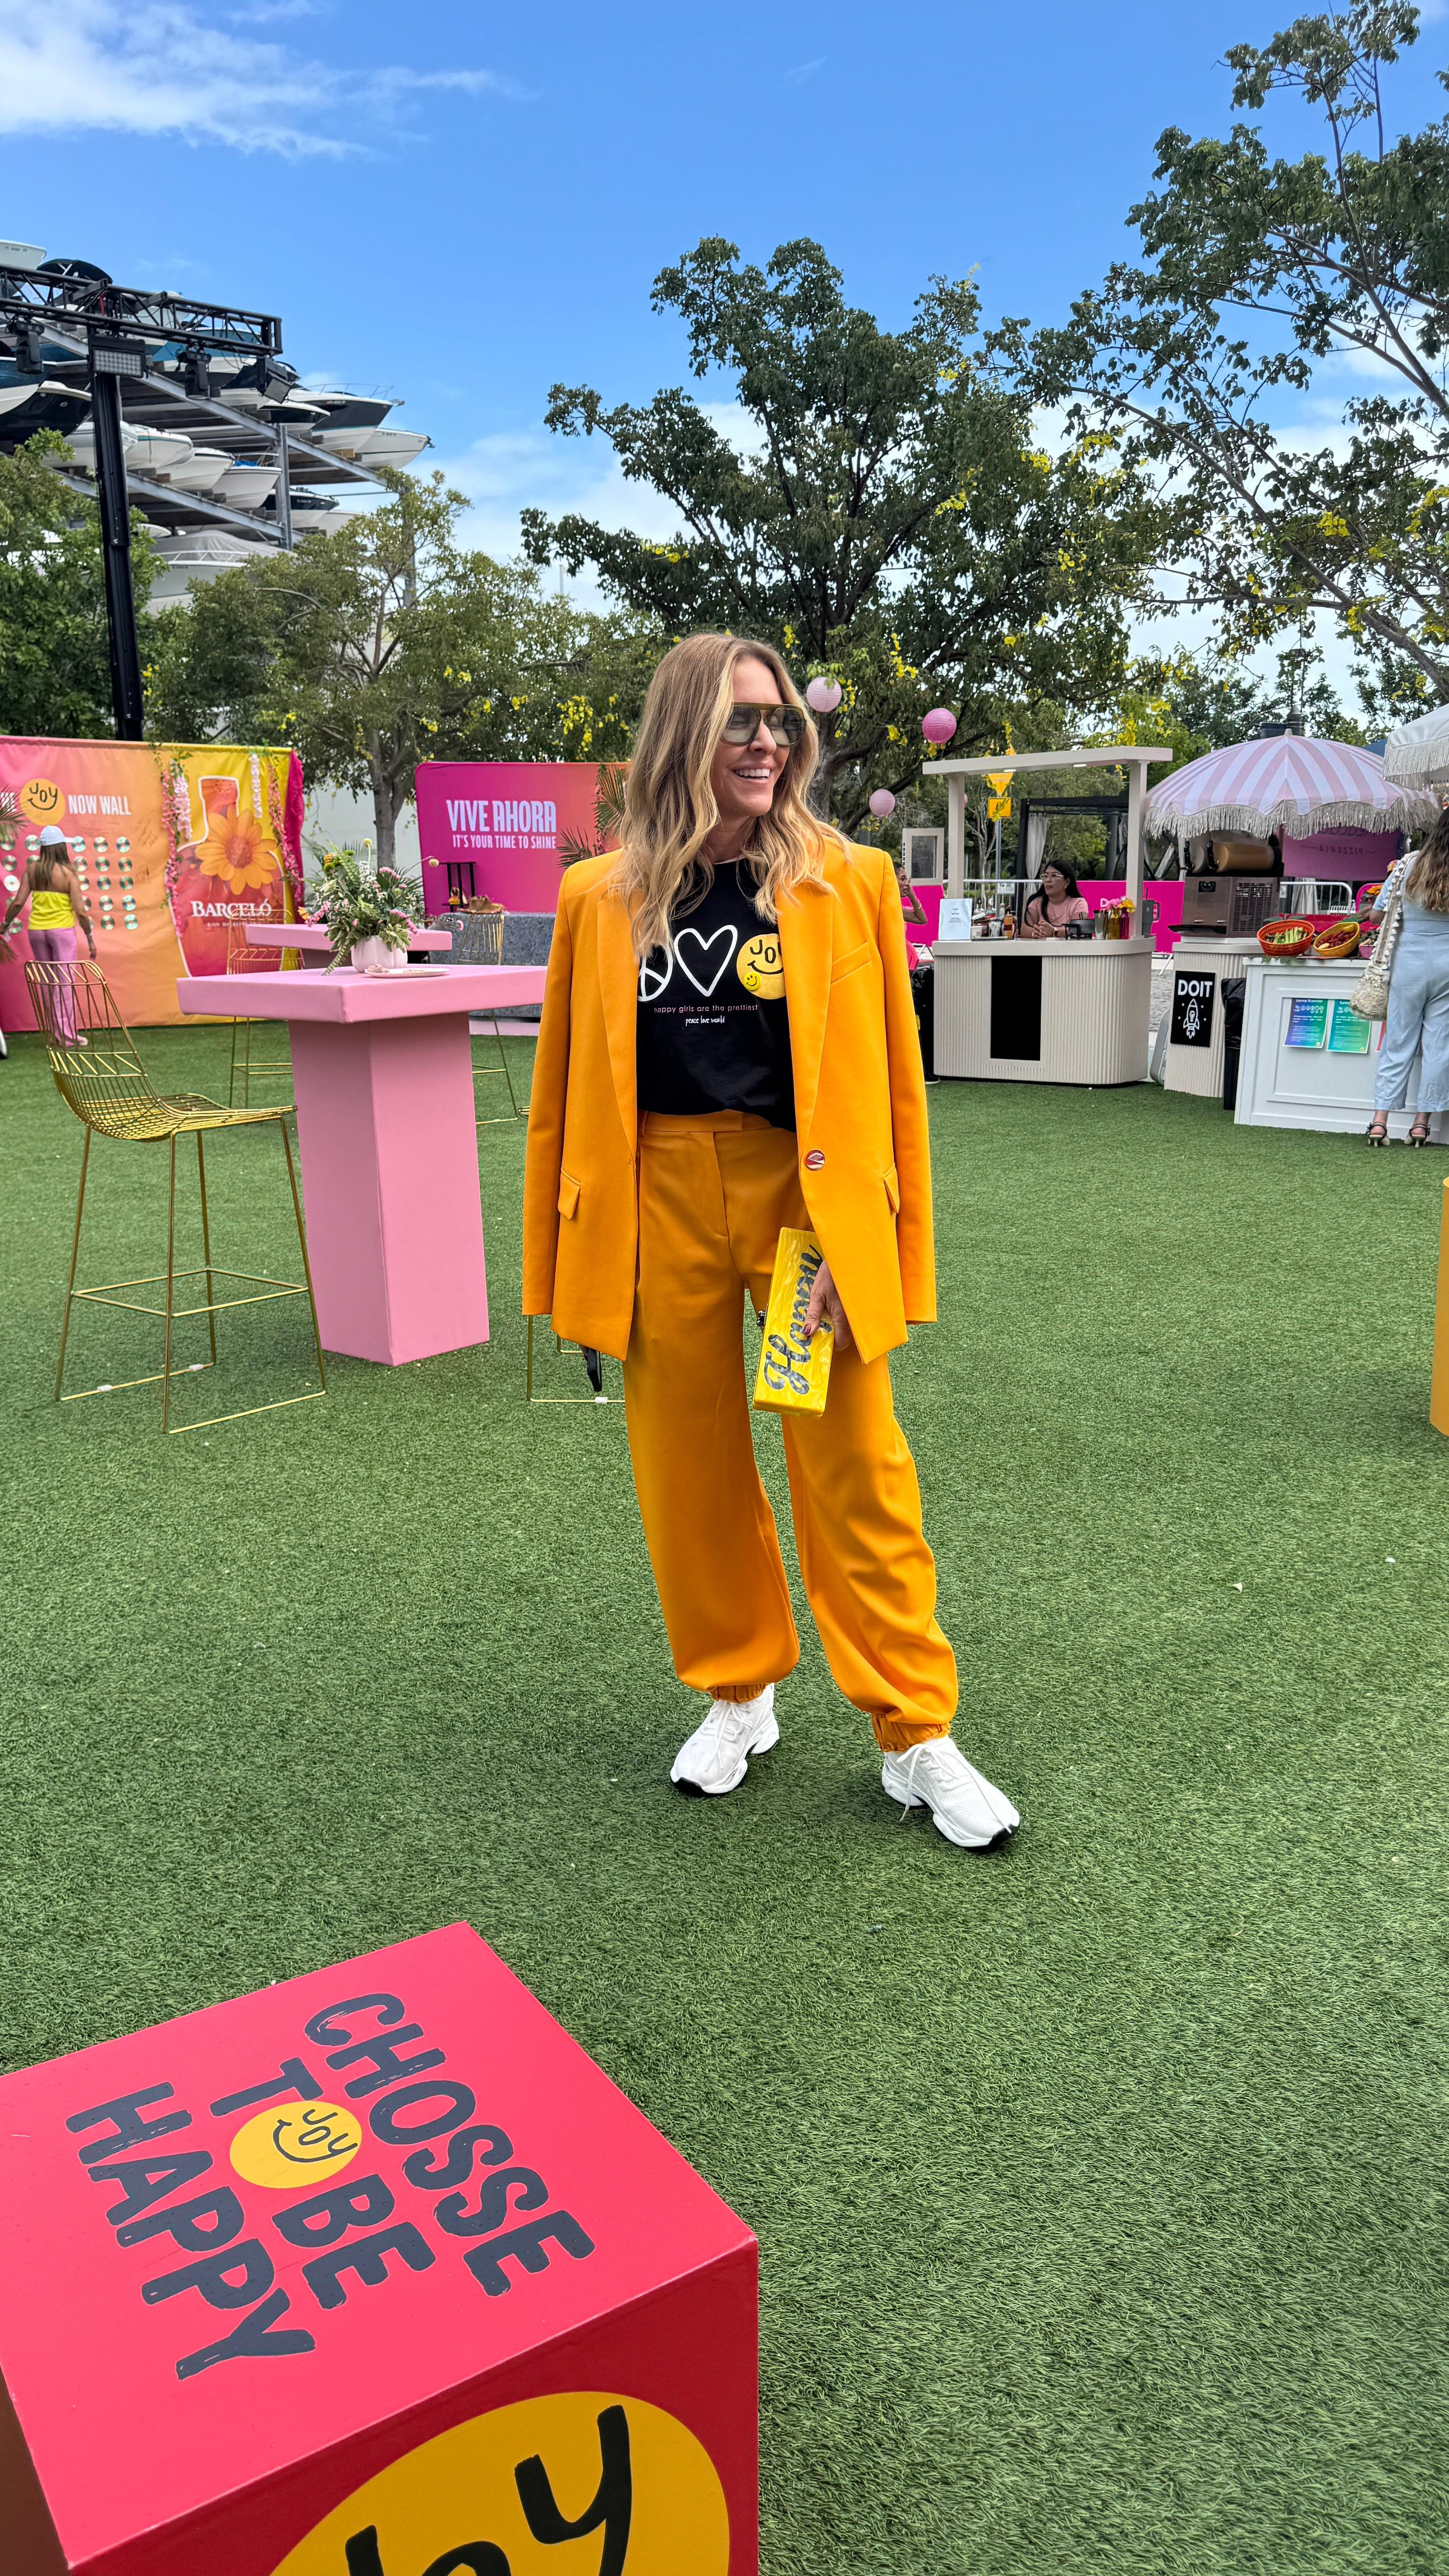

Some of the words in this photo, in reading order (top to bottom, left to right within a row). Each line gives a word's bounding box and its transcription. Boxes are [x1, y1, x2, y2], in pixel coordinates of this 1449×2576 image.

[68, 795, 97, 814] NOW
[99, 796, 132, 815] WALL
[446, 799, 490, 832] VIVE
[492, 800, 556, 833] AHORA
[453, 834, 468, 848] IT'S
[470, 835, 493, 848] YOUR
[495, 835, 516, 848] TIME
[518, 836, 528, 848] TO
[531, 836, 556, 849] SHINE
[191, 898, 272, 920] BARCELÓ
[1177, 979, 1213, 998] DOIT
[679, 1005, 694, 1013] girls
[685, 1017, 699, 1026] peace
[701, 1015, 709, 1024] love
[711, 1015, 725, 1024] world
[304, 1993, 596, 2297] CHOSSE
[66, 2082, 315, 2381] HAPPY
[272, 2174, 436, 2310] BE
